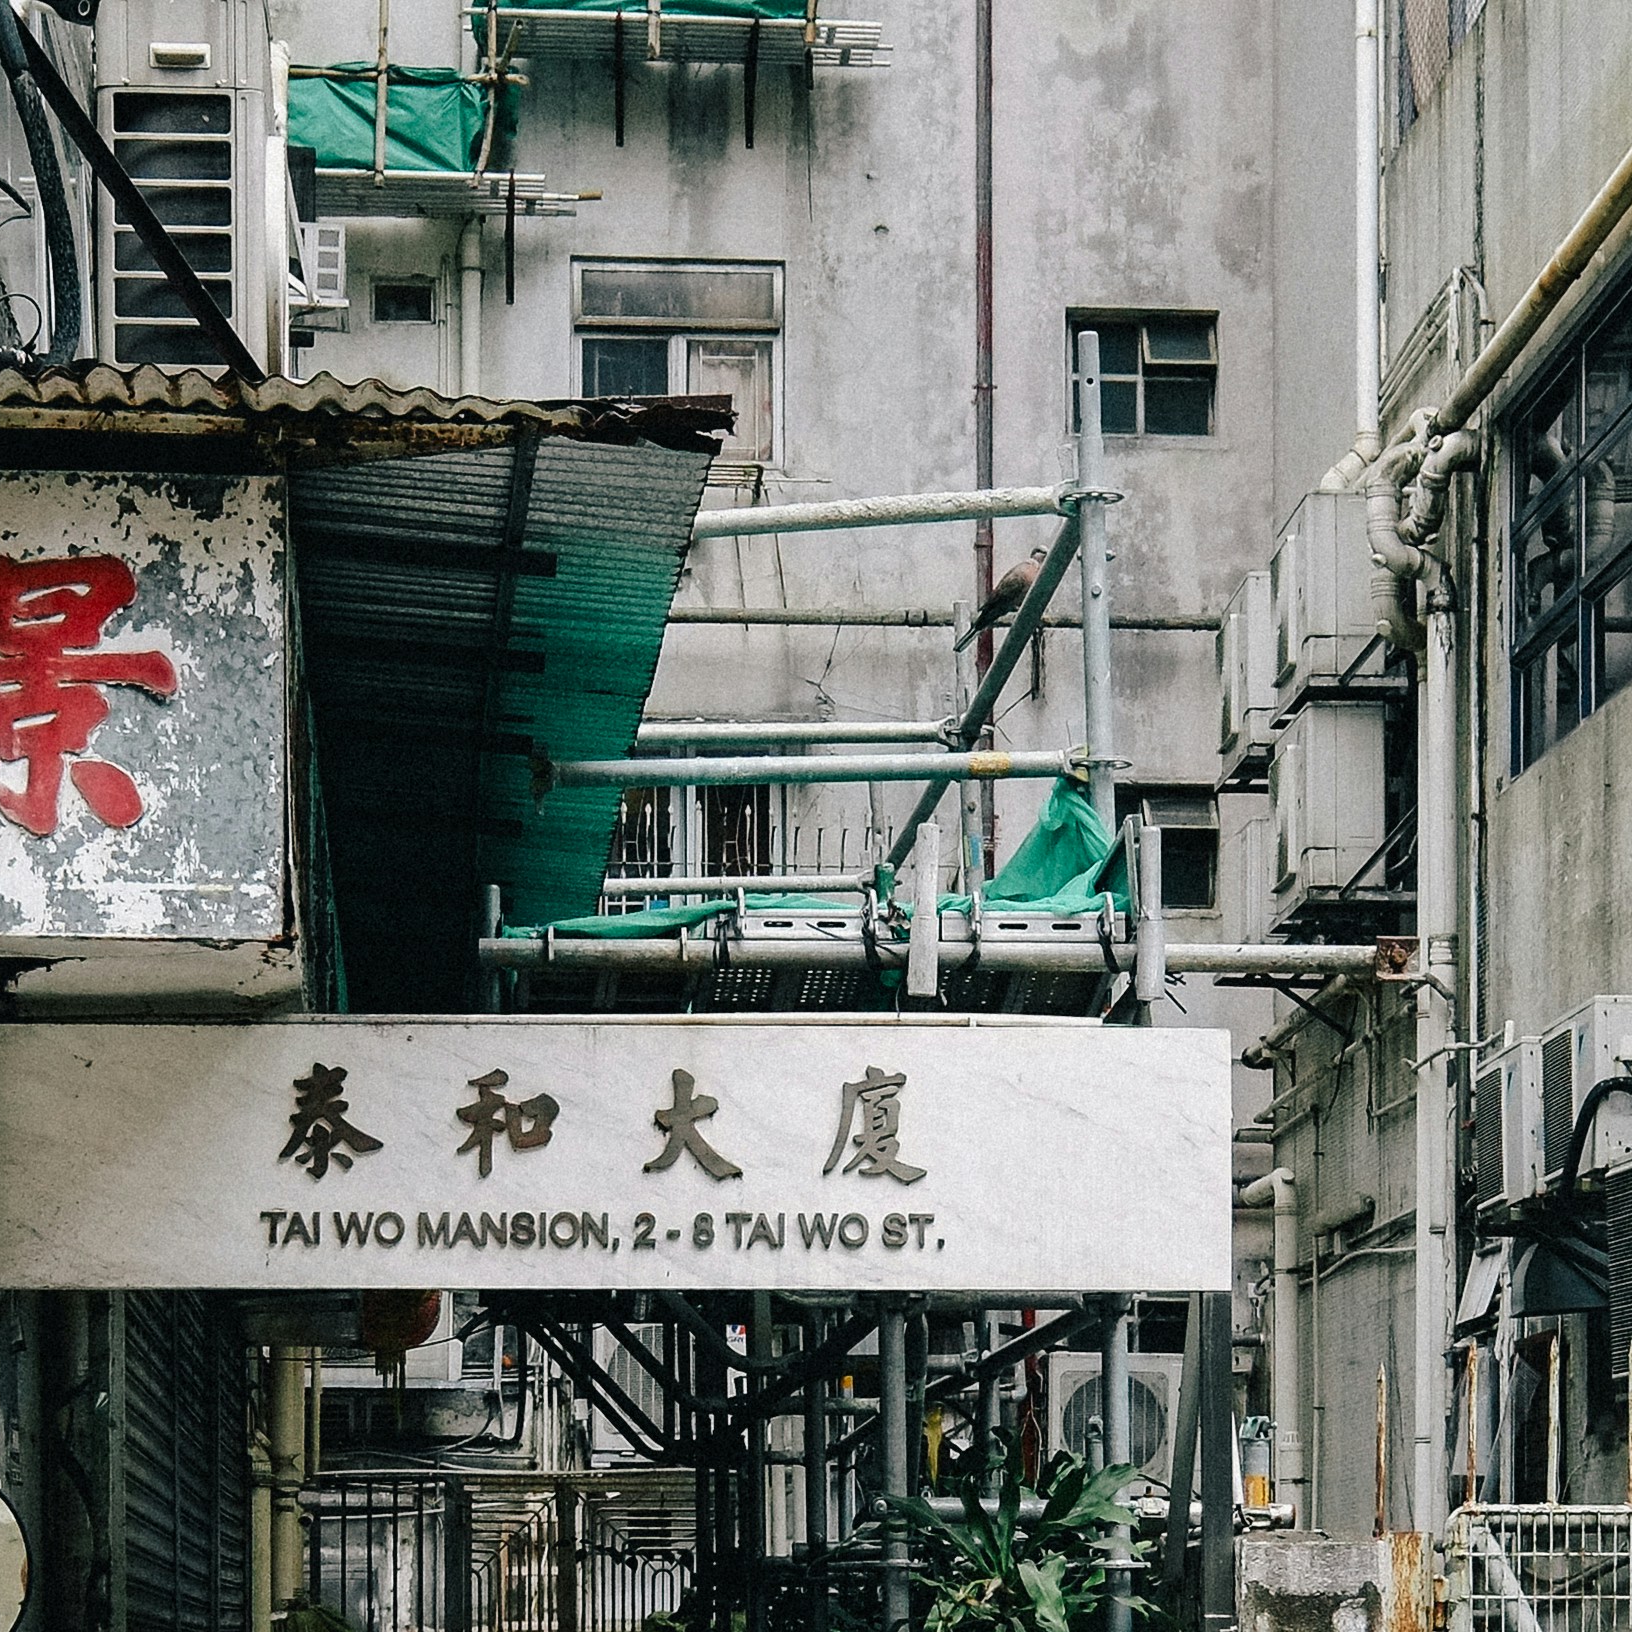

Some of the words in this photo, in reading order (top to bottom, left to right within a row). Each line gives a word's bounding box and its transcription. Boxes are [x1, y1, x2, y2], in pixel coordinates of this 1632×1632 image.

[278, 1062, 928, 1186] 泰和大廈
[260, 1211, 322, 1250] TAI
[334, 1211, 406, 1250] WO
[417, 1211, 621, 1254] MANSION,
[725, 1212, 786, 1250] TAI
[798, 1212, 869, 1250] WO
[881, 1212, 945, 1251] ST.
